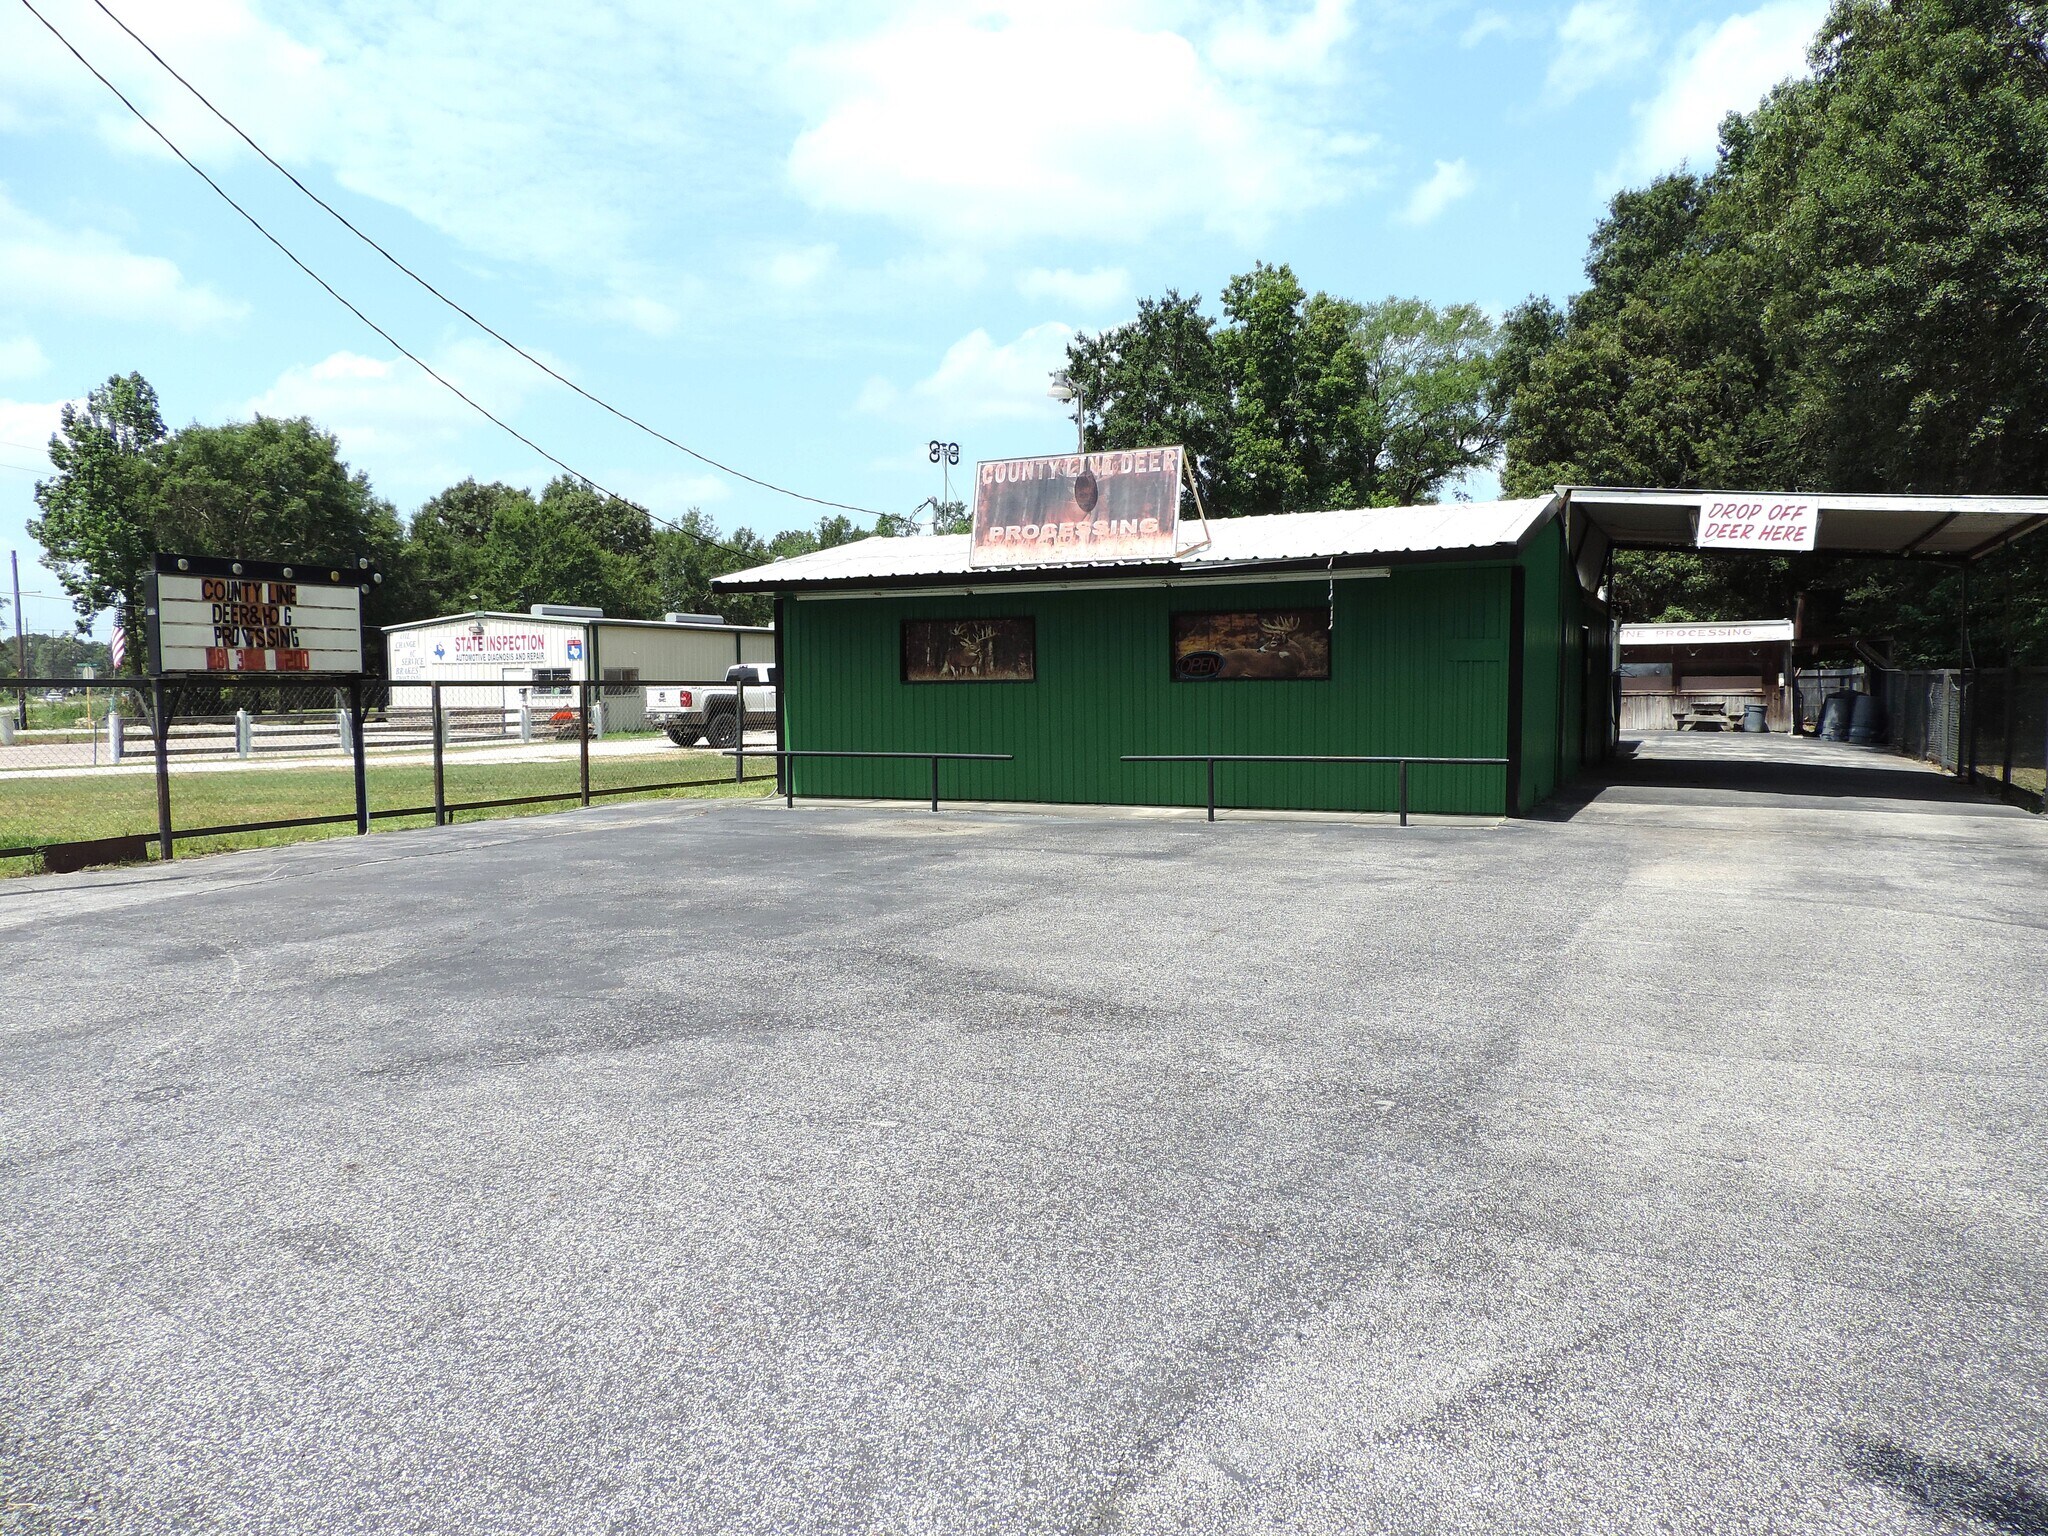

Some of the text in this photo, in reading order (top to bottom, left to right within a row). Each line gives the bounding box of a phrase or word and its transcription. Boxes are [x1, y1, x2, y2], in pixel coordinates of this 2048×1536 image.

[982, 451, 1177, 485] COUNTY LINE DEER
[1708, 503, 1807, 521] DROP OFF
[989, 517, 1159, 541] PROCESSING
[1704, 523, 1807, 542] DEER HERE
[201, 580, 297, 605] COUNTY LINE
[1656, 627, 1752, 638] PROCESSING
[395, 640, 417, 649] CHANGE
[455, 634, 545, 652] STATE INSPECTION
[402, 657, 425, 666] SERVICE
[455, 652, 545, 662] AUTOMOTIVE DIAGNOSIS AND REPAIR
[1180, 657, 1219, 673] OPEN
